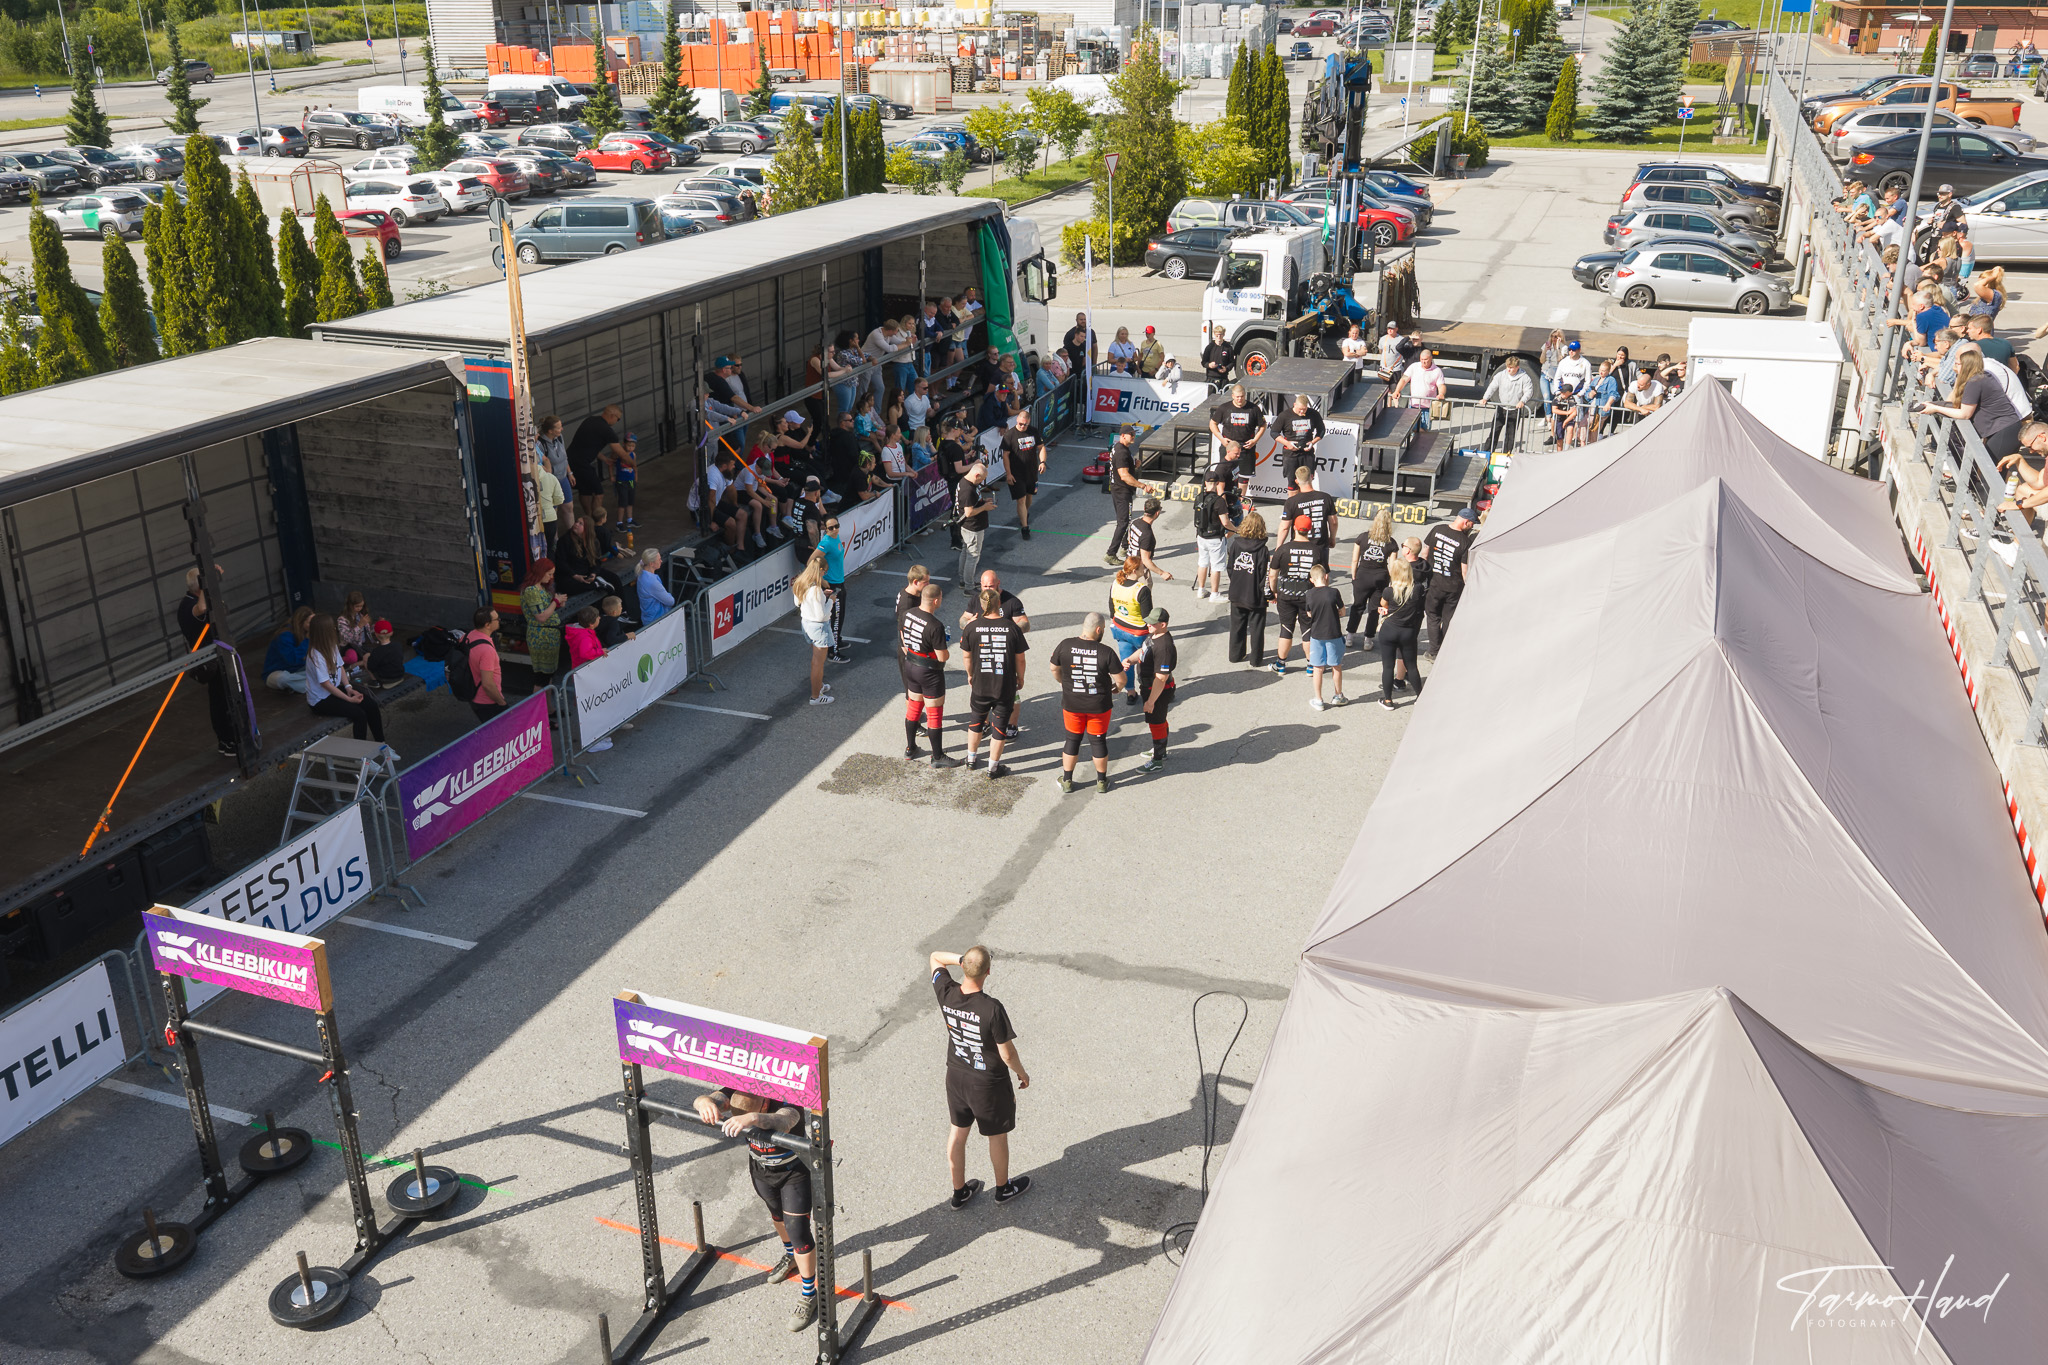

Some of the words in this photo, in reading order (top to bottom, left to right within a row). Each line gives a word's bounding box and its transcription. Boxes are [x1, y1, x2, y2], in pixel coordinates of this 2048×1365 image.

[1098, 394, 1116, 407] 24
[1120, 397, 1128, 408] 7
[1171, 483, 1201, 501] 200
[1393, 503, 1426, 524] 200
[853, 511, 892, 551] SPORT!
[716, 607, 732, 629] 24
[734, 601, 742, 618] 7
[1071, 647, 1098, 656] ZUKULIS
[581, 670, 633, 714] Woodwell
[450, 720, 543, 799] KLEEBIKUM
[221, 842, 321, 926] EESTI
[196, 942, 308, 985] KLEEBIKUM
[942, 1004, 981, 1024] SEKRETÄR
[673, 1033, 810, 1083] KLEEBIKUM
[746, 1070, 806, 1090] REKLAAM
